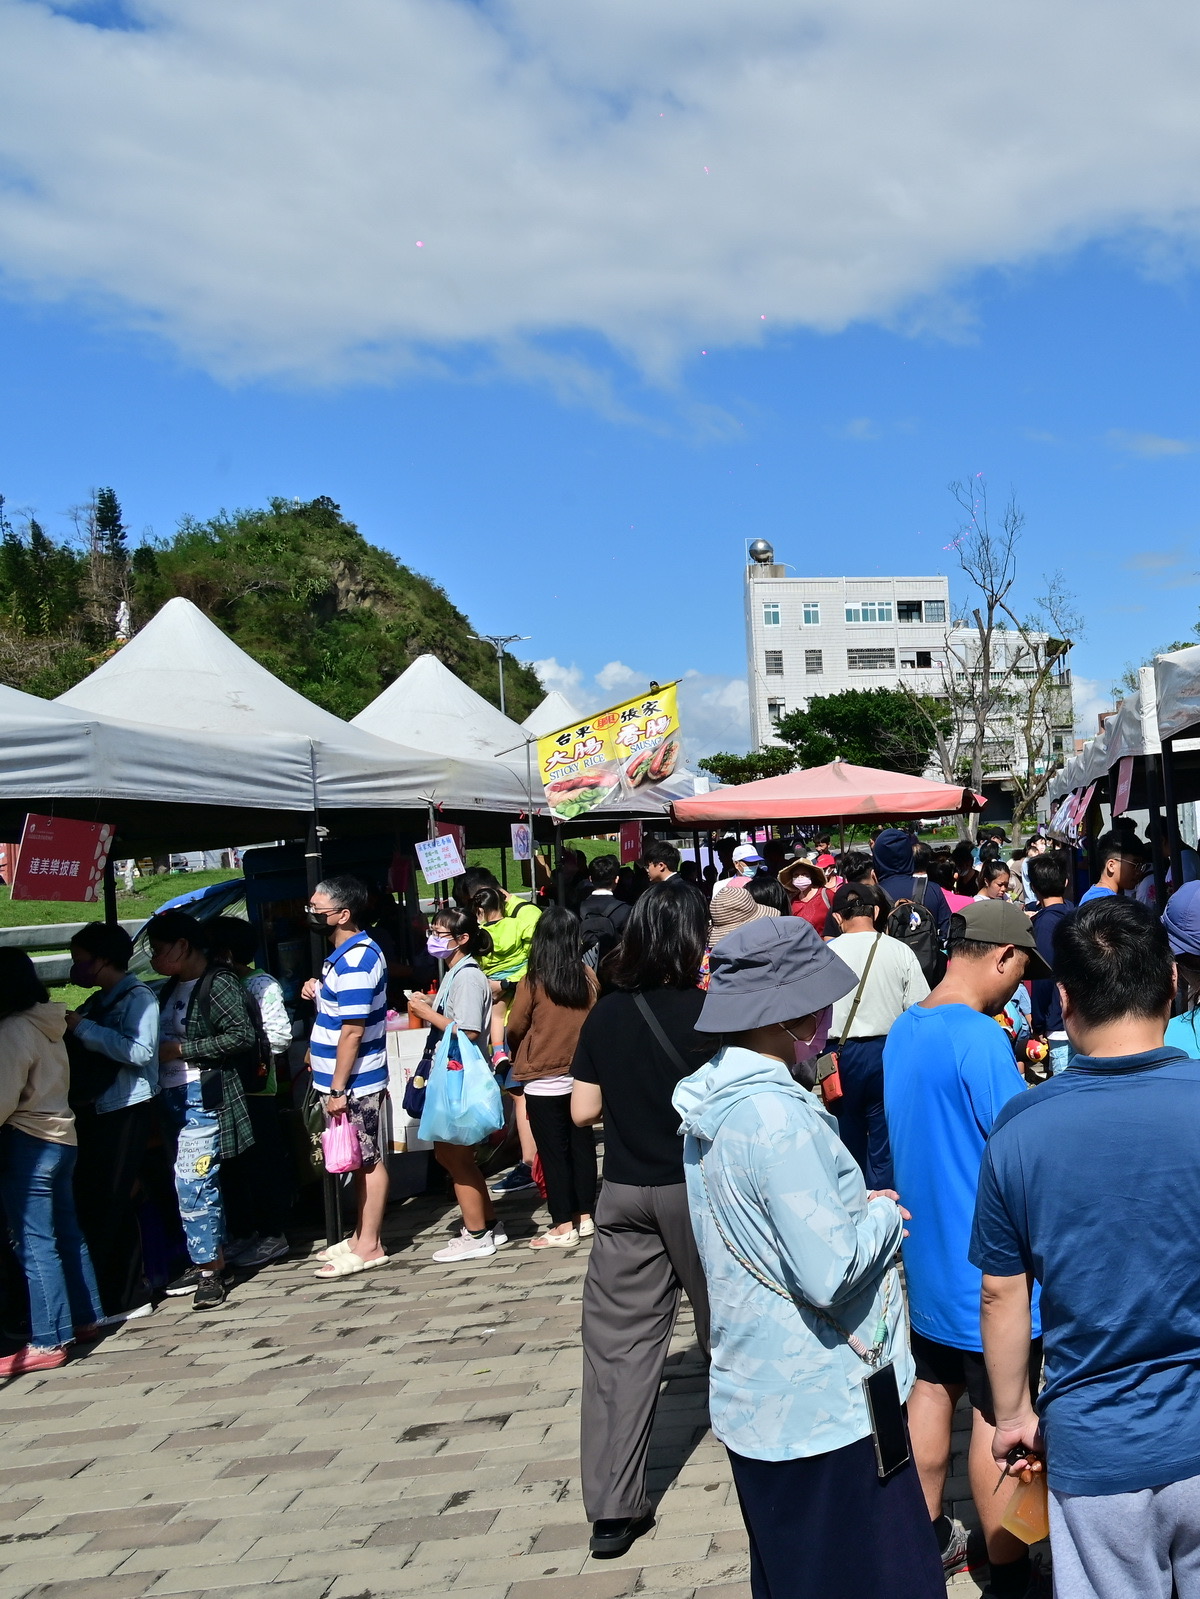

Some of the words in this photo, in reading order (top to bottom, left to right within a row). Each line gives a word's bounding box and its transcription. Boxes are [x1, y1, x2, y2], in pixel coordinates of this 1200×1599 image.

[615, 714, 673, 748] 香腸
[543, 735, 604, 772] 大腸
[550, 762, 579, 781] STICKY
[583, 753, 606, 768] RICE
[28, 857, 80, 877] 達美樂披薩
